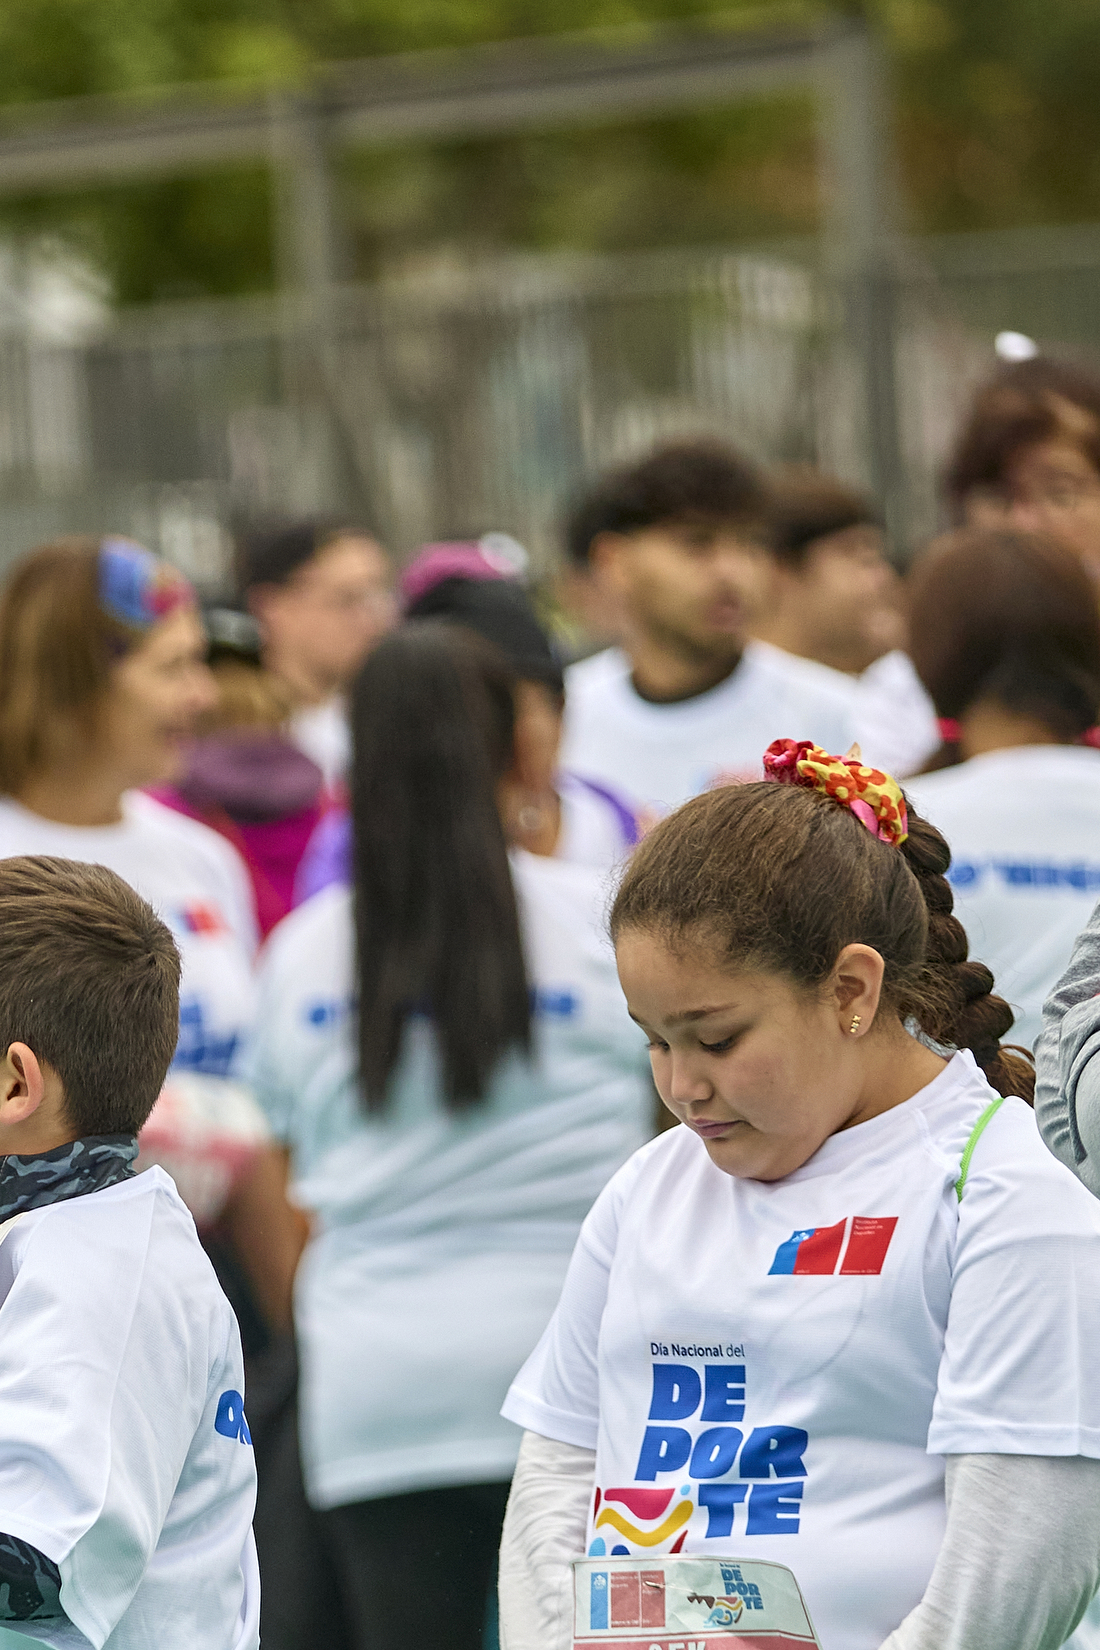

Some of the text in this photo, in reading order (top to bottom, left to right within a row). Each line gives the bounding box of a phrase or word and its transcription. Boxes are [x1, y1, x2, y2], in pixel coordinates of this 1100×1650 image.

[651, 1342, 745, 1357] Día Nacional del
[648, 1363, 747, 1422] DE
[634, 1425, 808, 1481] POR
[698, 1481, 804, 1539] TE
[720, 1568, 744, 1582] DE
[724, 1581, 761, 1596] POR
[742, 1596, 764, 1610] TE
